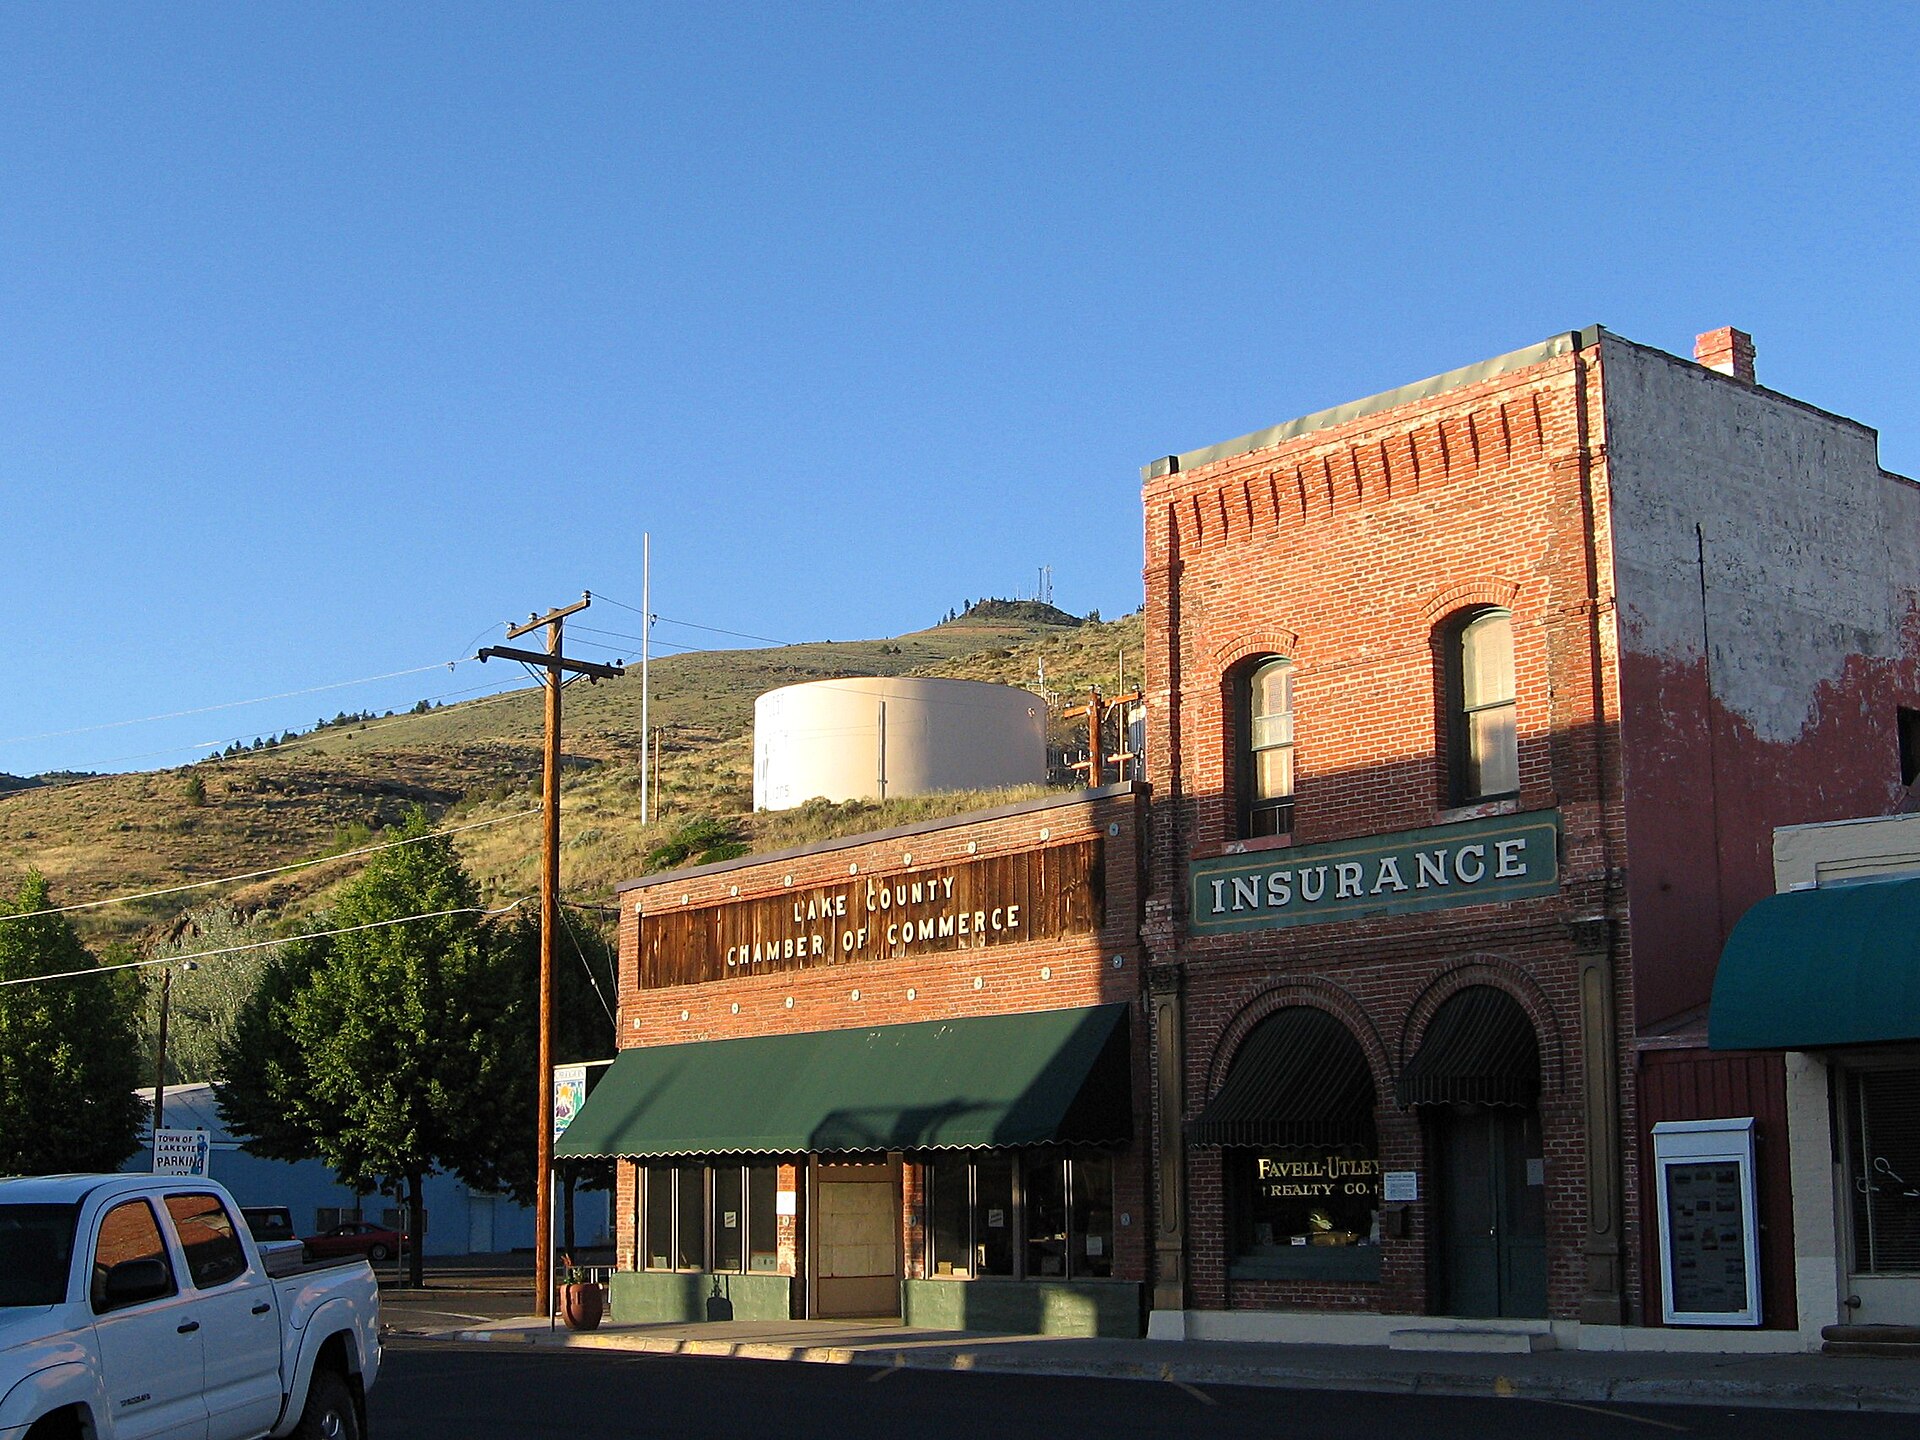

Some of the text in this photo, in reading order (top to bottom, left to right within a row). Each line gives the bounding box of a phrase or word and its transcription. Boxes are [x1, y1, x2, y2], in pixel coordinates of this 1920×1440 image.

[1211, 838, 1528, 913] INSURANCE
[793, 876, 954, 923] LAKE COUNTY
[727, 904, 1020, 967] CHAMBER OF COMMERCE
[158, 1135, 180, 1143] TOWN
[156, 1155, 204, 1169] PARKING
[1270, 1182, 1370, 1196] REALTY CO.
